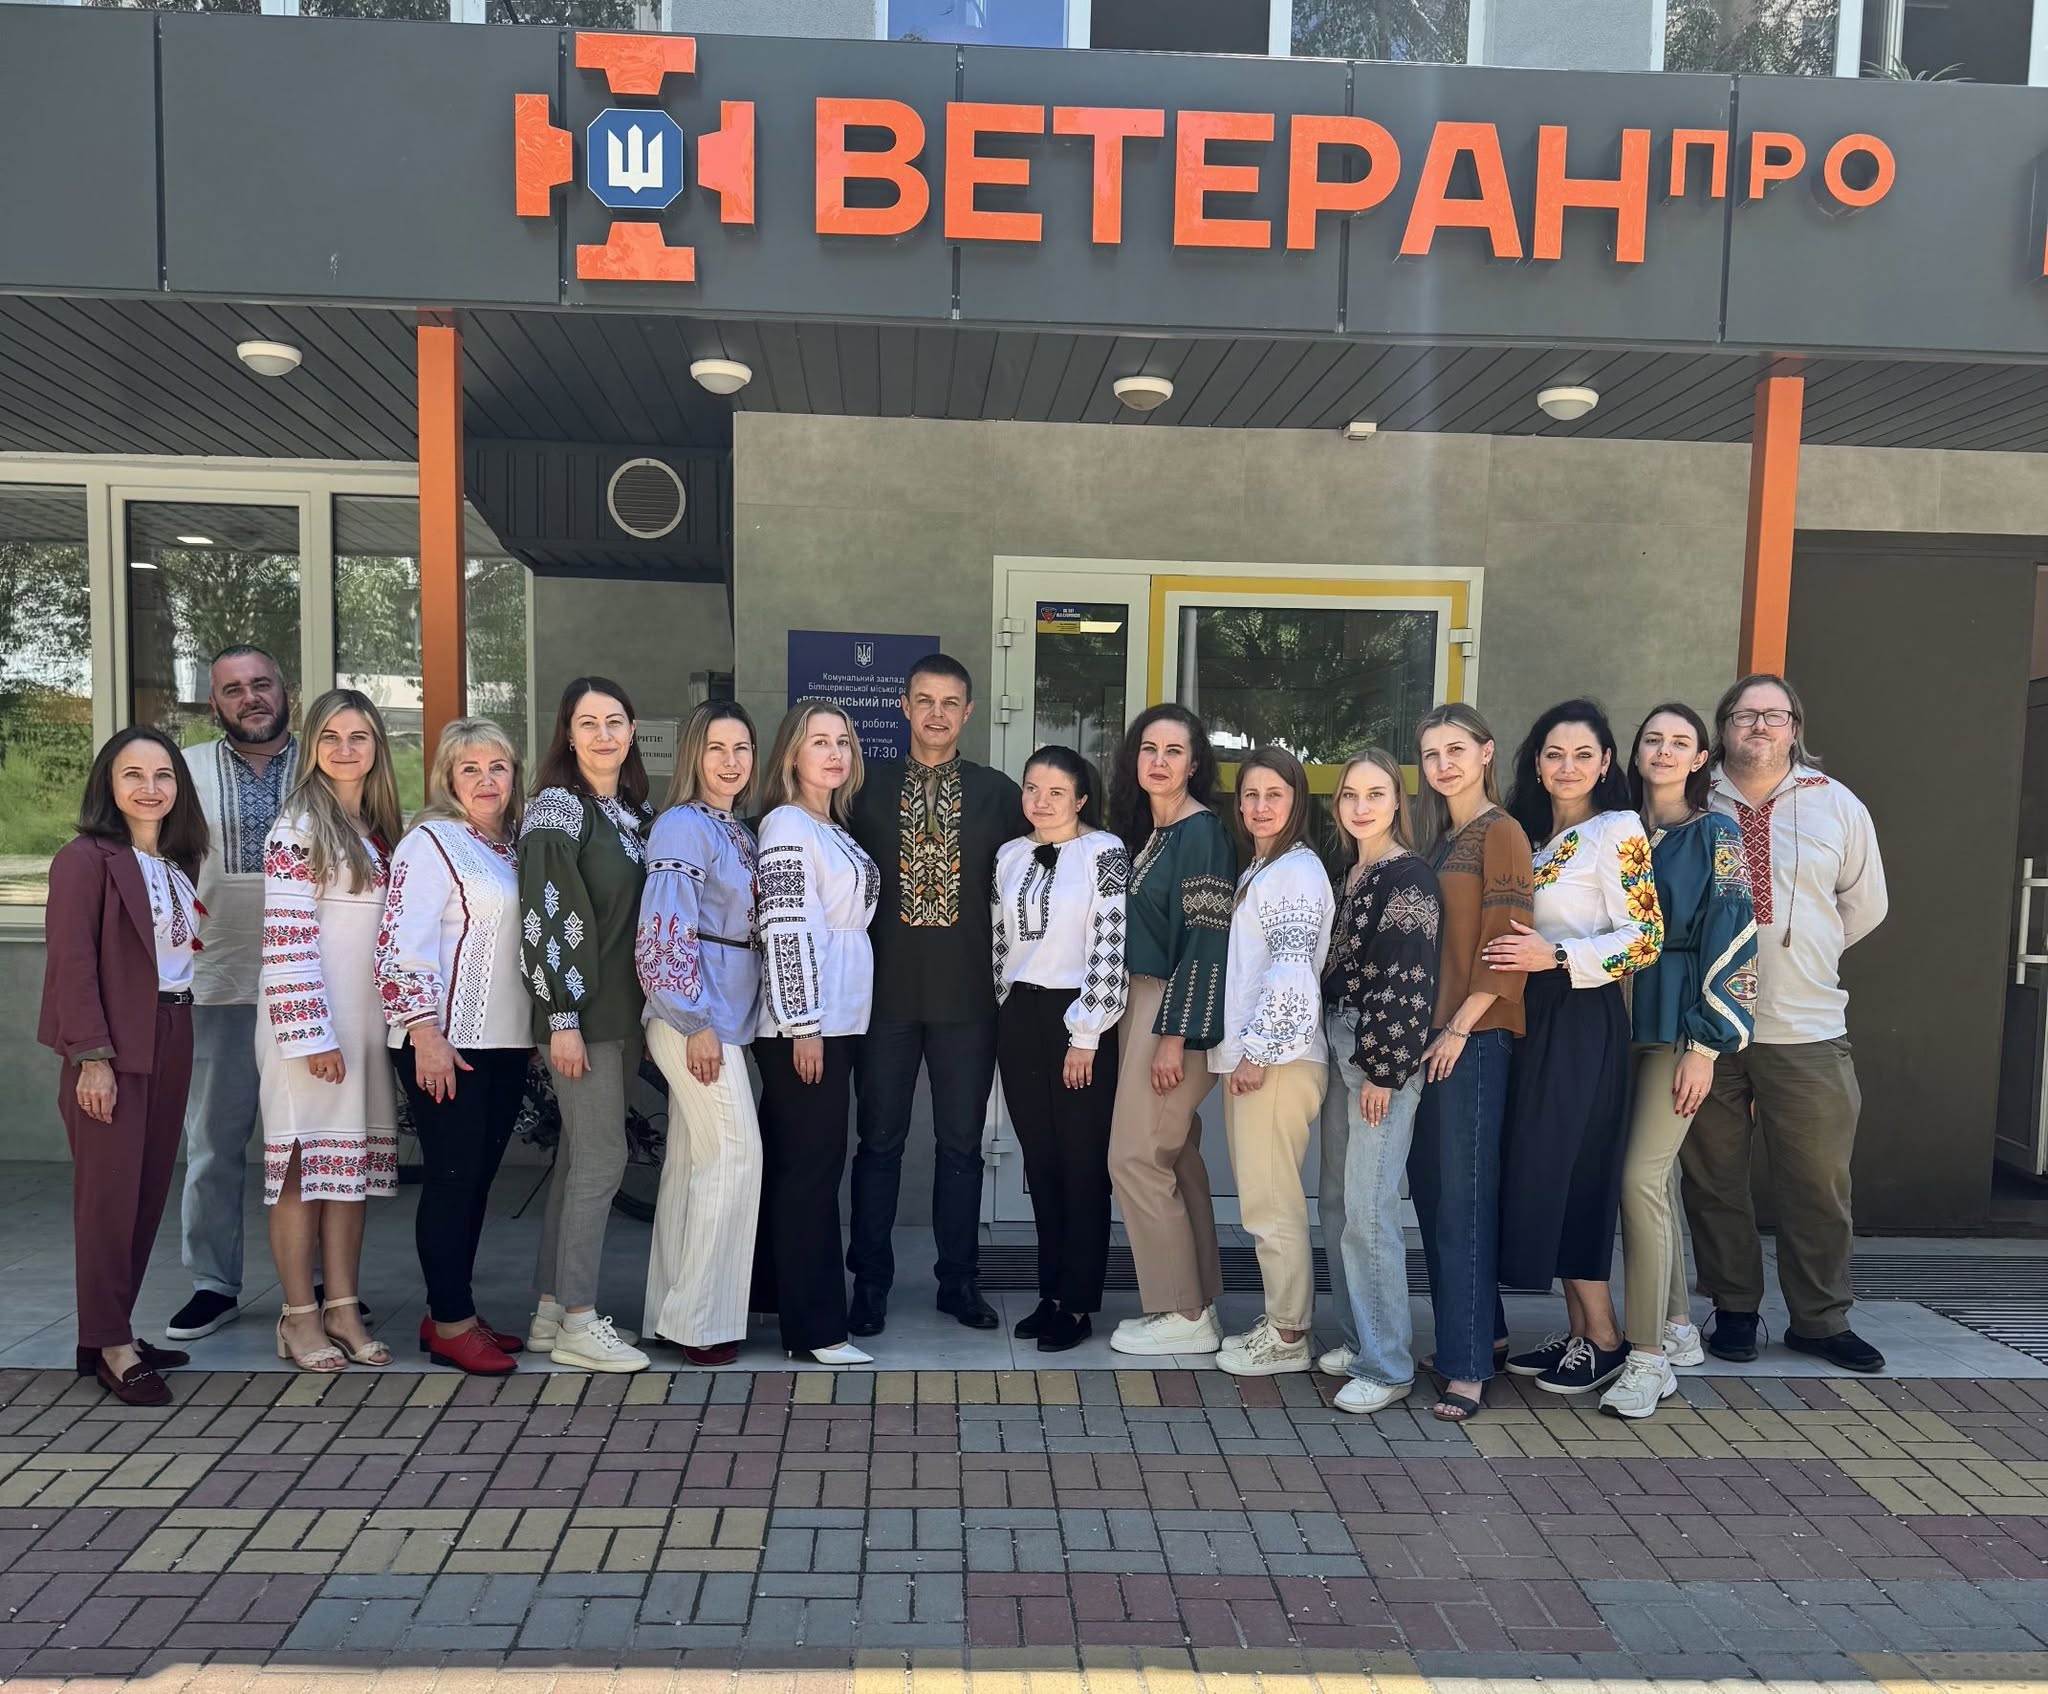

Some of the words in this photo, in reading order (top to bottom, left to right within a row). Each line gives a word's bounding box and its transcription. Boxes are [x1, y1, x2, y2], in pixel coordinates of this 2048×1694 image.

[816, 97, 1651, 263] ВЕТЕРАН
[1670, 129, 1896, 207] ПРО
[823, 672, 875, 683] Комунальний
[876, 676, 905, 684] заклад
[862, 718, 899, 730] роботи:
[863, 746, 898, 759] -17:30
